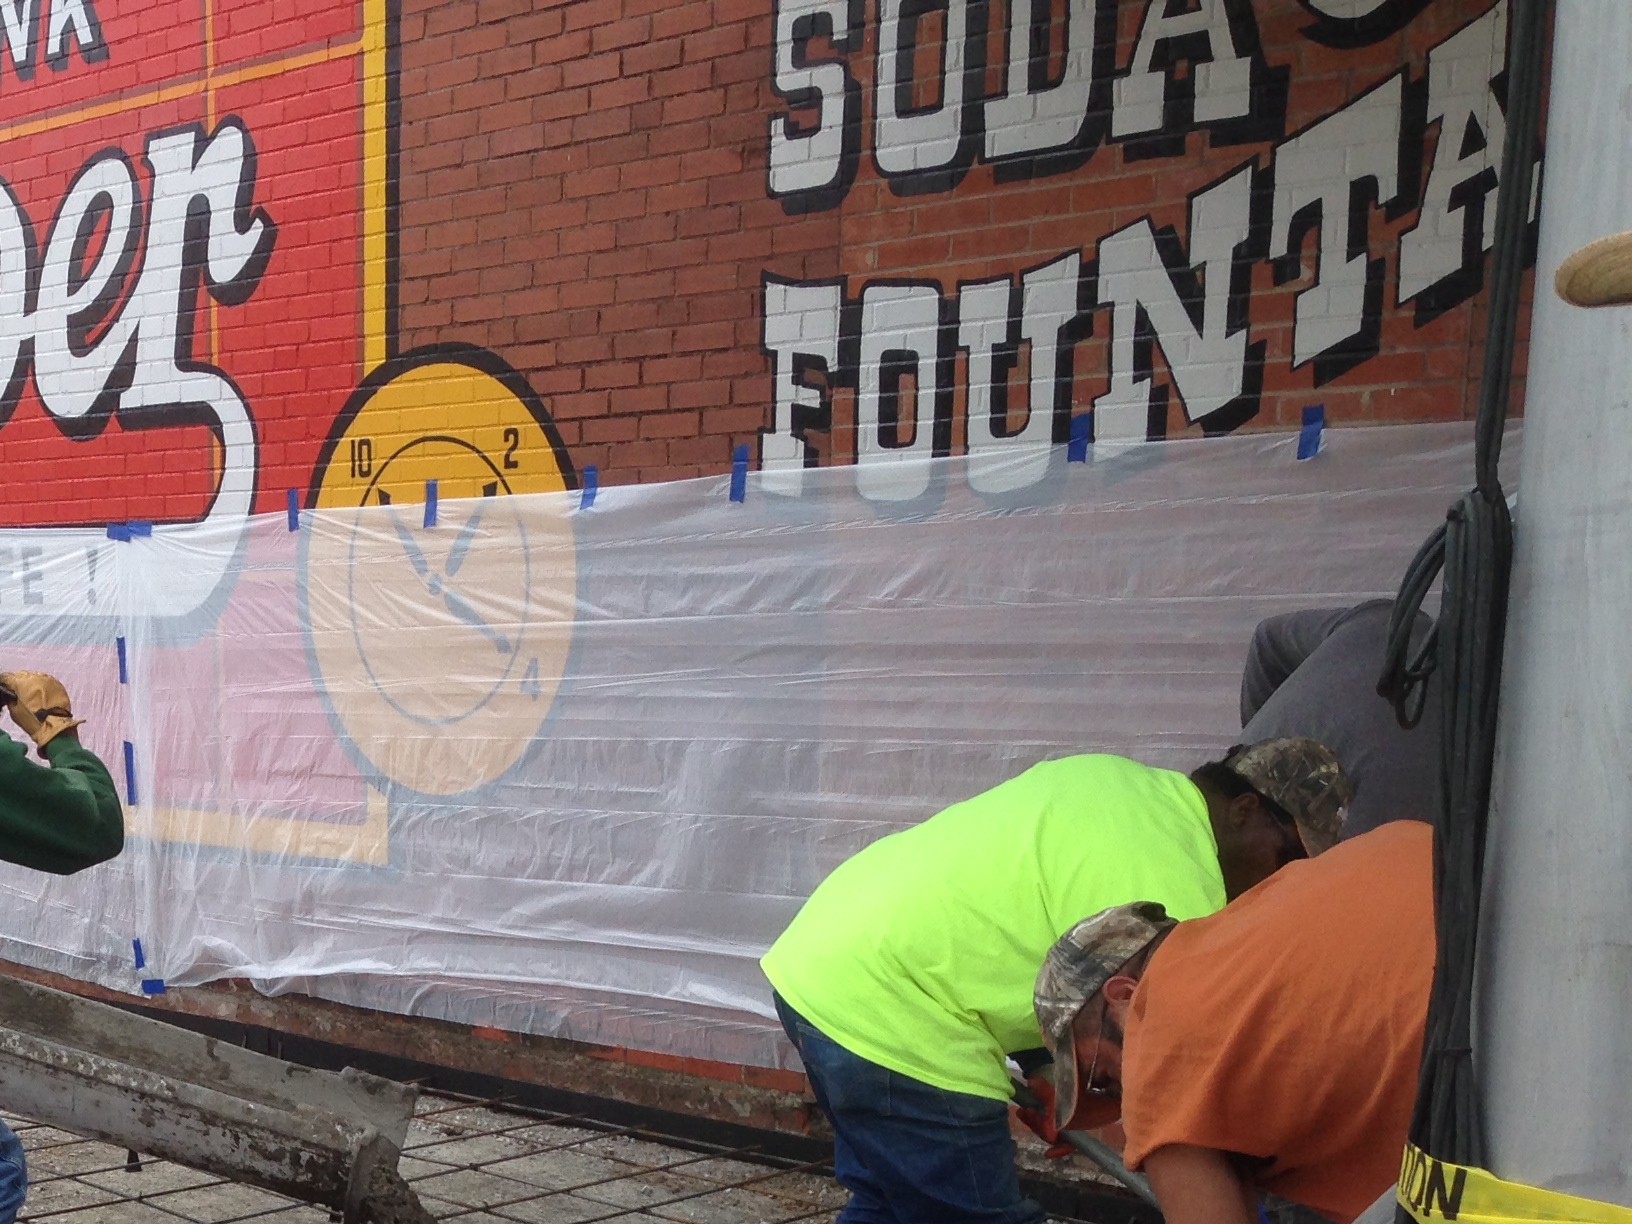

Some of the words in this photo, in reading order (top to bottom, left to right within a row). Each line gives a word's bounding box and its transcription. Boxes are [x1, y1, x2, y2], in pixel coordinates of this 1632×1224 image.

[765, 0, 1273, 205] SODA
[760, 0, 1542, 502] FOUNTA
[350, 438, 373, 478] 10
[503, 427, 519, 470] 2
[519, 656, 541, 701] 4
